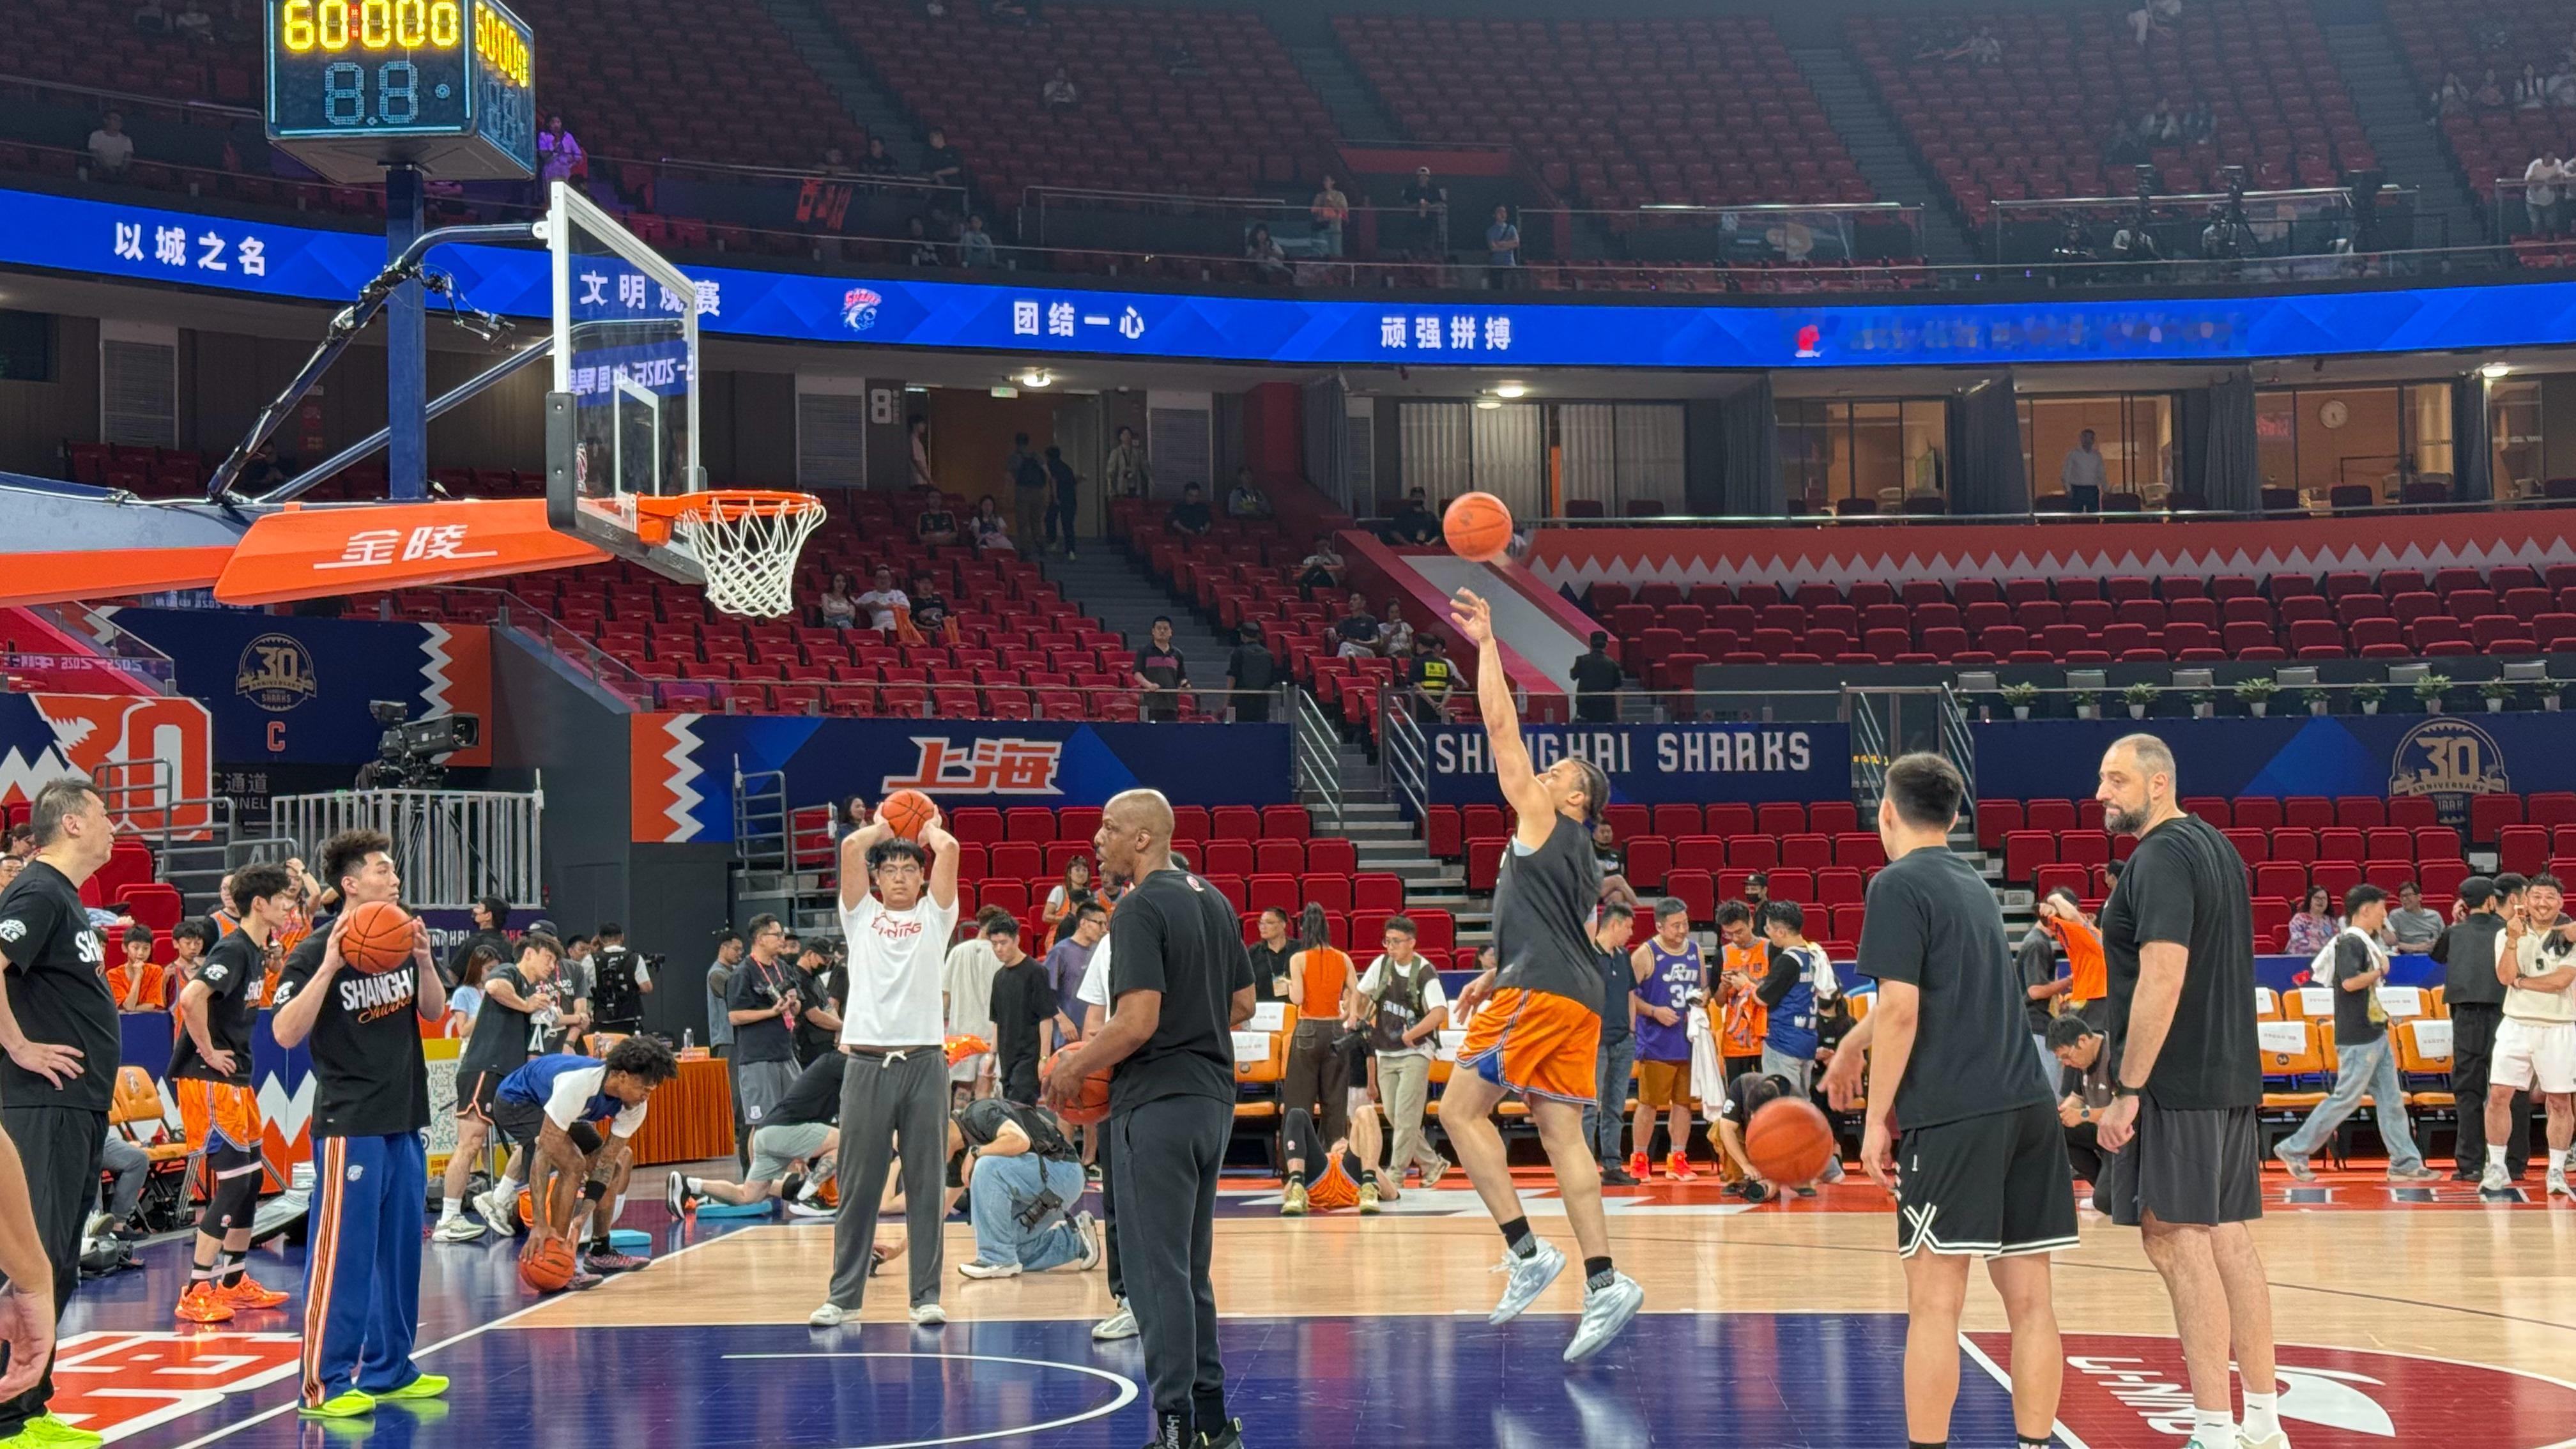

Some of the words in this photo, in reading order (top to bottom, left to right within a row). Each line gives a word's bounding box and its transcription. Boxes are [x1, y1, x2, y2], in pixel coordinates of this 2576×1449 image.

[114, 222, 265, 277] 以城之名
[1013, 300, 1146, 339] 团结一心
[1380, 316, 1512, 351] 顽强拼搏
[871, 388, 892, 424] 8
[313, 525, 498, 569] 金陵
[256, 647, 298, 682] 30
[267, 721, 286, 751] C
[1435, 733, 1630, 773] SHGHAI
[1657, 732, 1811, 772] SHARKS
[881, 737, 1066, 795] 上海
[2415, 736, 2480, 783] 30
[2412, 781, 2485, 794] ANNIVERSARY
